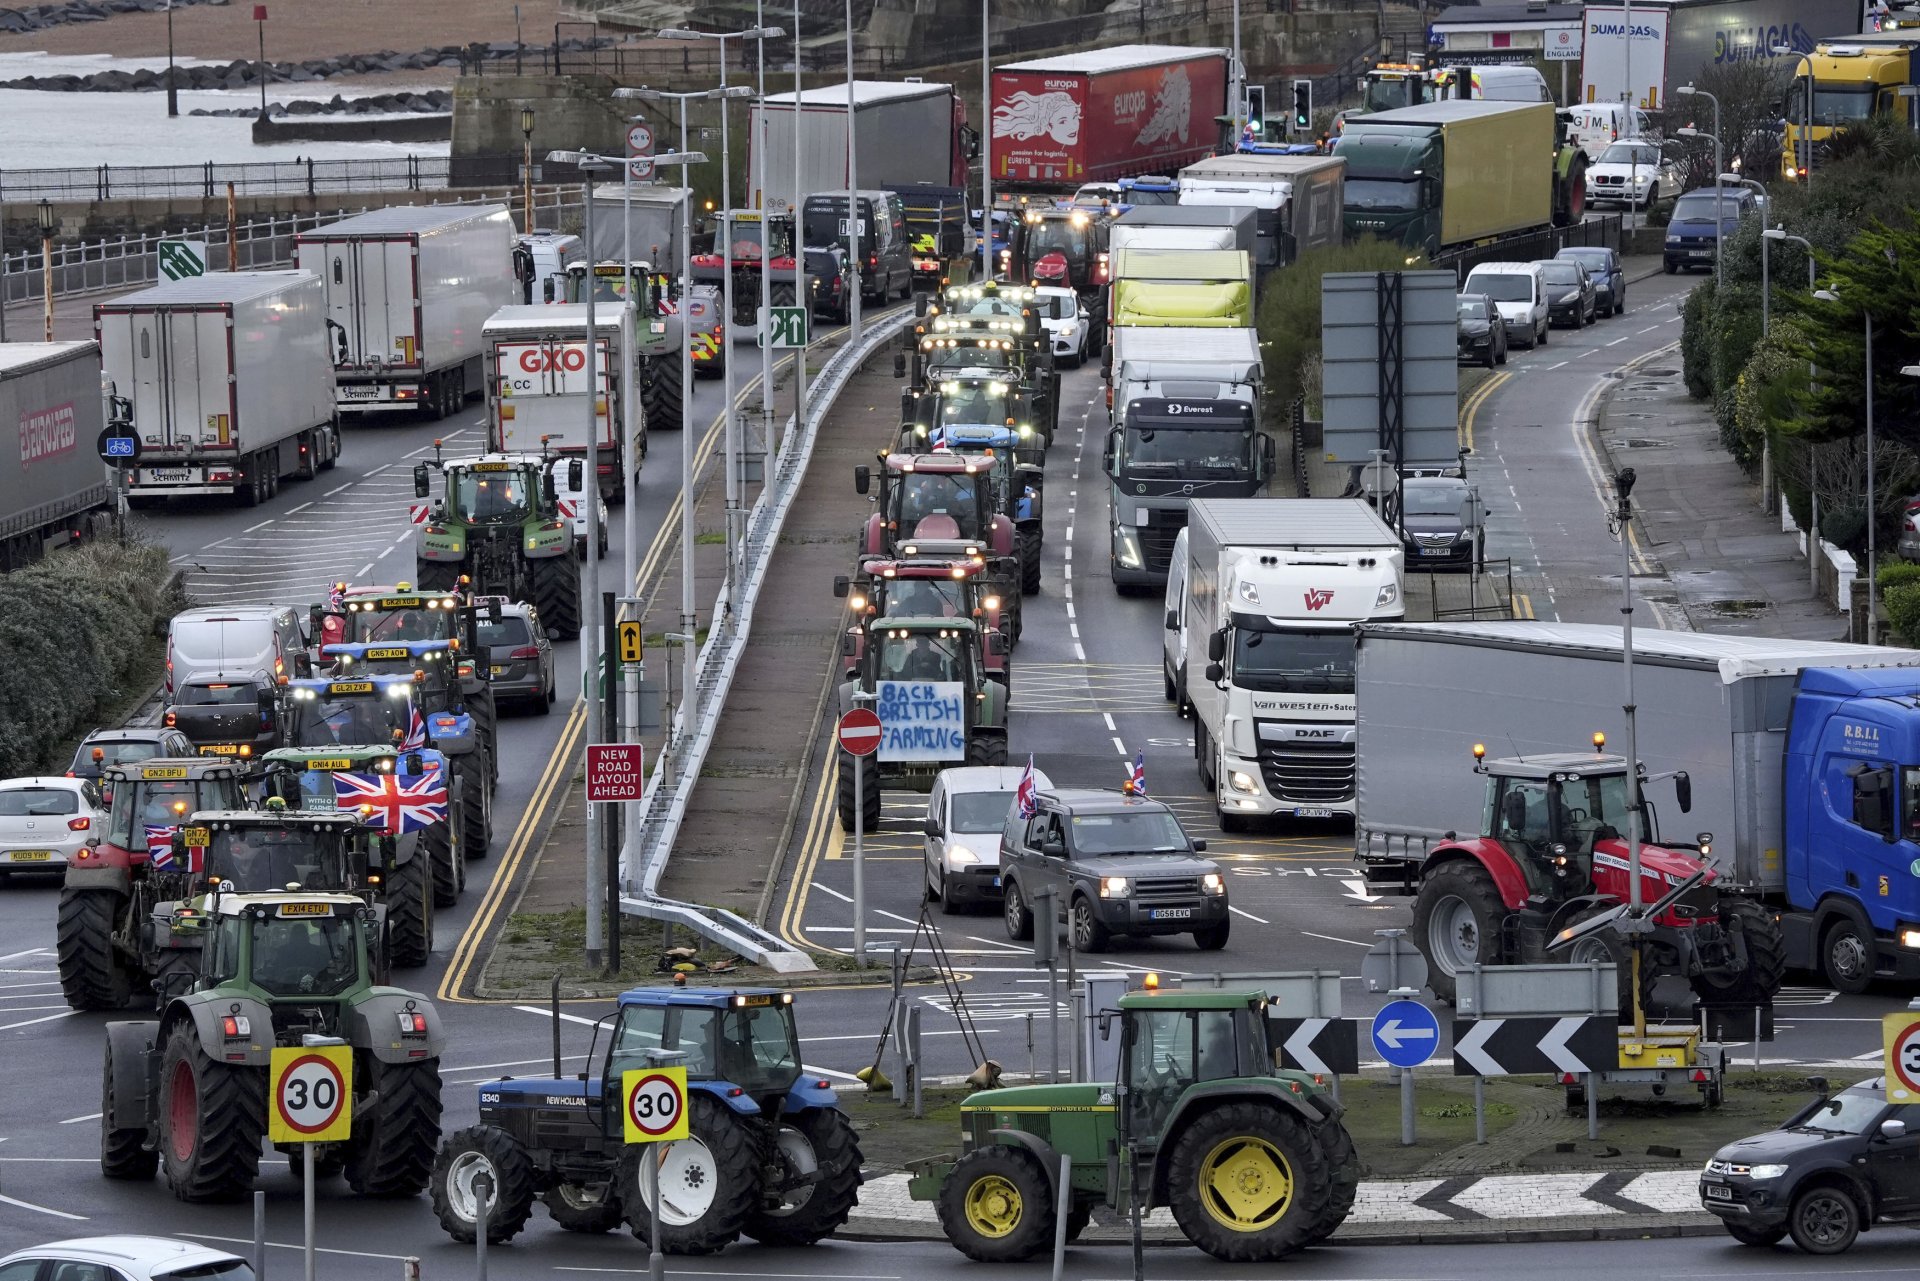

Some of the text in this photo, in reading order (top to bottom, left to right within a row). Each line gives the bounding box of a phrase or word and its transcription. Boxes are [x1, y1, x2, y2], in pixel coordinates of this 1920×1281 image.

[1590, 24, 1651, 36] DUMAGAS
[1714, 22, 1799, 65] DUMAGAS
[1044, 79, 1078, 90] europa
[1114, 89, 1146, 119] europa
[1355, 219, 1386, 228] IVECO
[519, 349, 585, 373] GXO
[344, 391, 378, 399] SCHMITZ
[1183, 405, 1214, 414] Everest
[153, 474, 191, 482] SCHMITZ
[336, 683, 367, 692] GL21 ZXF
[881, 683, 935, 702] BACK
[1253, 700, 1276, 710] Van
[1279, 702, 1330, 711] westen
[879, 725, 966, 751] FARMING
[1295, 729, 1335, 738] DAF
[600, 749, 629, 760] NEW
[312, 760, 345, 768] GN14 AUL
[597, 761, 632, 772] ROAD
[148, 769, 182, 777] GN21 BFU
[592, 773, 638, 784] LAYOUT
[593, 785, 636, 796] AHEAD
[186, 829, 208, 837] GN72
[287, 904, 325, 913] FX14 ETU
[1176, 909, 1190, 917] EVC
[1904, 1043, 1920, 1074] 3
[287, 1077, 336, 1111] 30
[481, 1093, 500, 1103] 8340
[546, 1096, 560, 1105] NEW
[637, 1092, 675, 1118] 30
